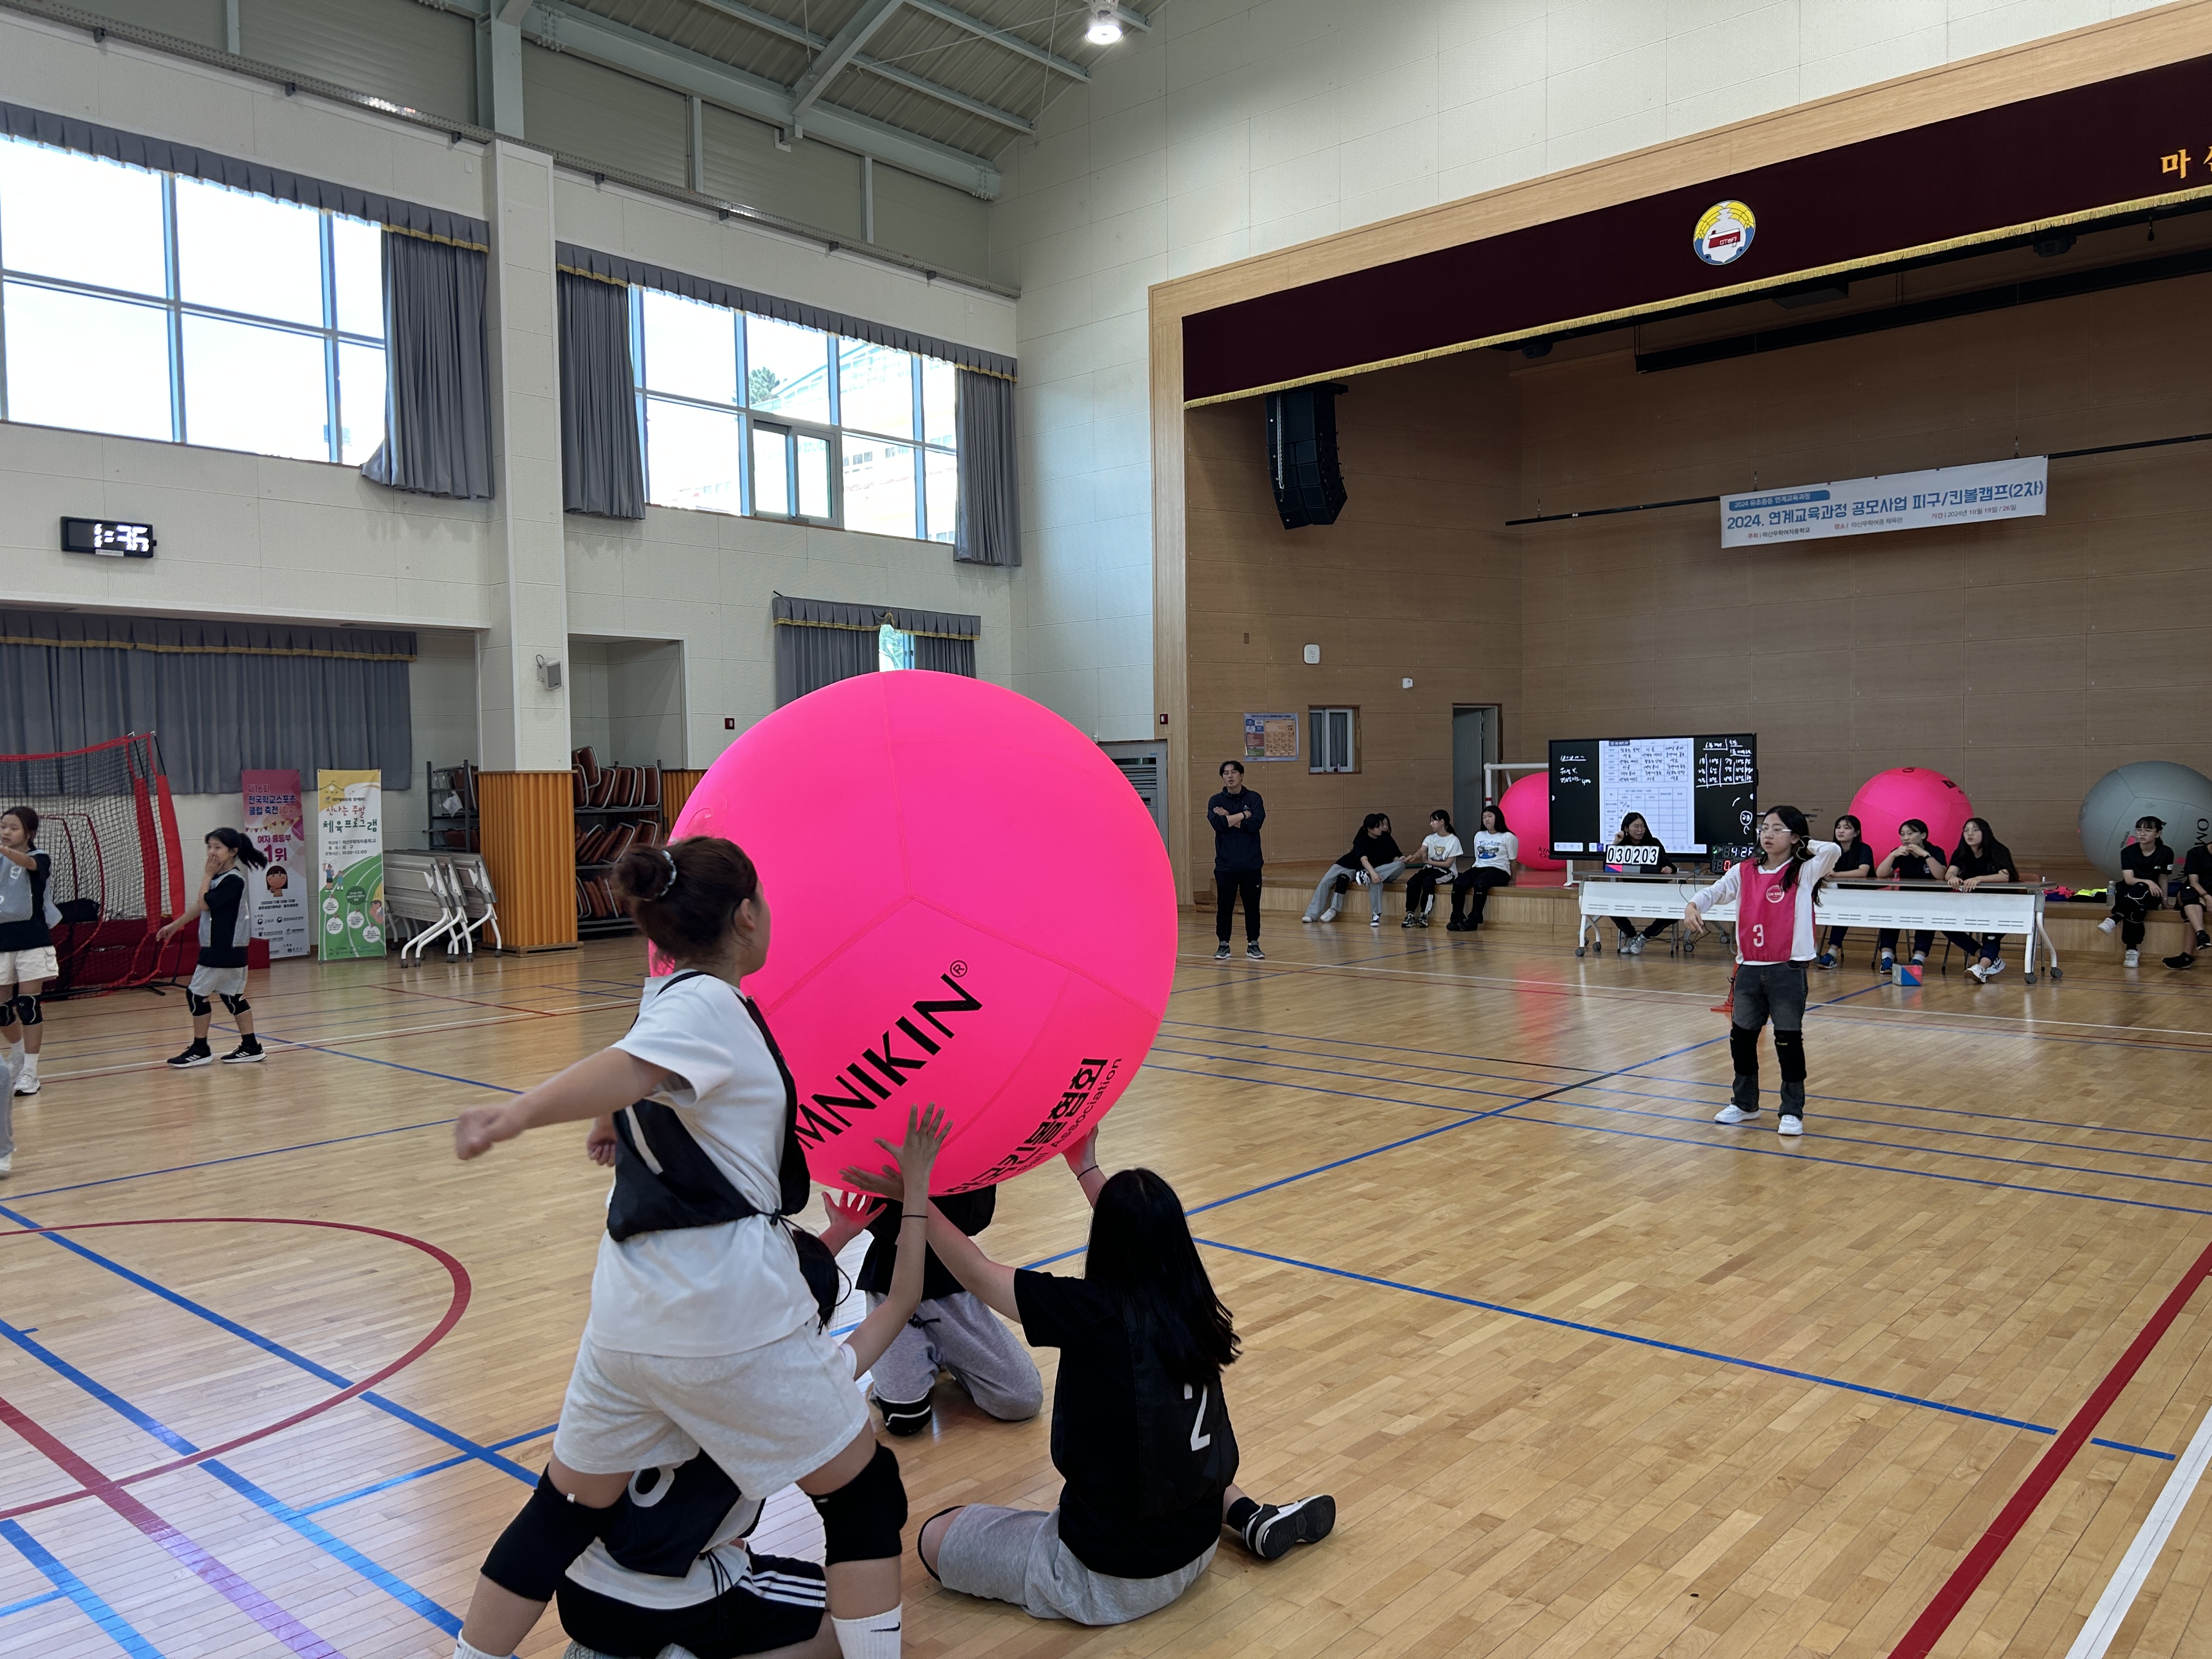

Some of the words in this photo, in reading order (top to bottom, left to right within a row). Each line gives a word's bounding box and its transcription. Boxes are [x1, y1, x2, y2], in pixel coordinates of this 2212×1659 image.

[1727, 514, 1764, 529] 2024.
[1769, 504, 1847, 526] 연계교육과정
[1852, 496, 1907, 516] 공모사업
[1912, 480, 2044, 509] 피구/킨볼캠프(2차)
[1948, 509, 1967, 517] 2024년
[249, 795, 296, 804] 전국학교스포츠
[249, 806, 263, 815] 클럽
[264, 806, 278, 815] 축전
[326, 805, 349, 816] 신나는
[352, 804, 366, 819] 주말
[323, 817, 377, 833] 체육프로그램
[258, 835, 270, 843] 여자
[264, 844, 287, 863] 1위
[1753, 924, 1764, 947] 3
[1183, 1383, 1211, 1452] 2
